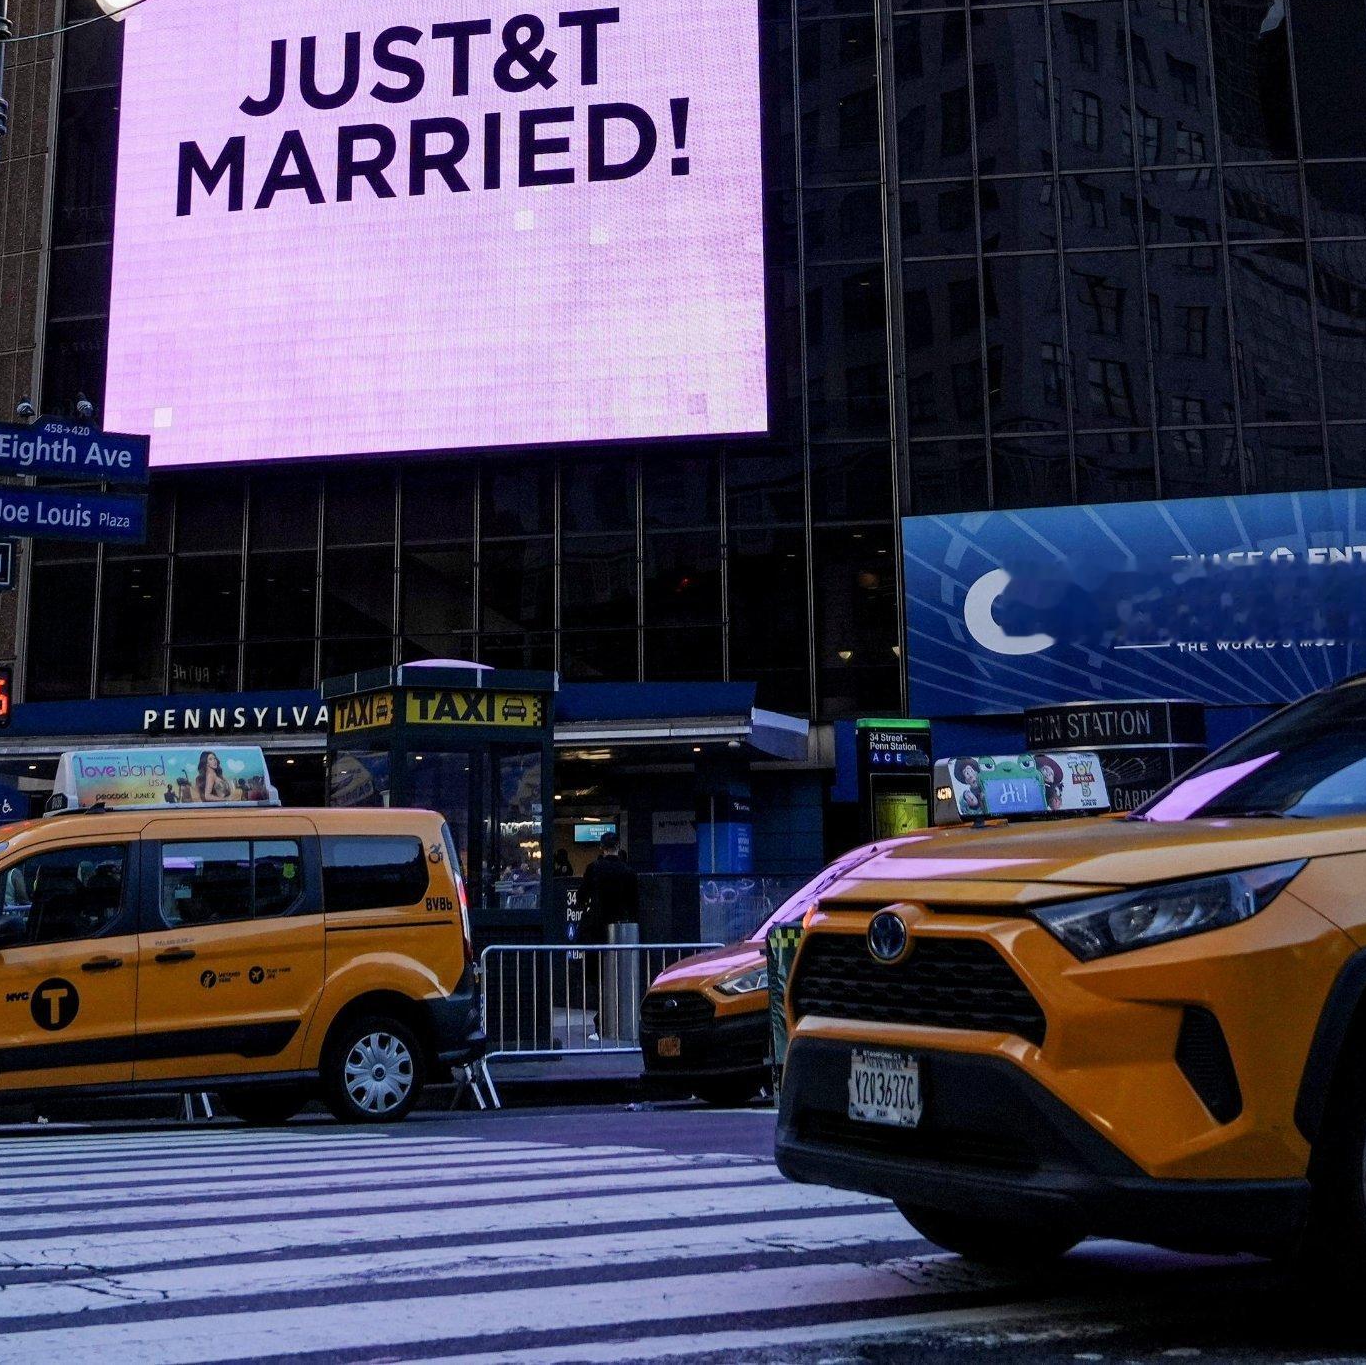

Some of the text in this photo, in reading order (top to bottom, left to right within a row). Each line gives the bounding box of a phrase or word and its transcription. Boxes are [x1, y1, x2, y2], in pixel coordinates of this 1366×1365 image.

[239, 7, 620, 116] JUST&T
[176, 97, 690, 217] MARRIED!
[44, 423, 90, 436] 458 420
[85, 441, 132, 468] Ave
[37, 502, 91, 527] Louis
[99, 512, 130, 528] Plaza
[143, 705, 329, 730] PENNSYLVA
[337, 694, 374, 730] TAXI
[412, 691, 496, 722] TAXI
[1067, 709, 1151, 738] STATION
[869, 733, 879, 742] 34
[869, 742, 917, 751] Penn Station
[79, 755, 166, 778] love island
[873, 753, 902, 762] A C E
[148, 779, 166, 787] USA
[1000, 782, 1028, 804] Hi!
[96, 792, 129, 801] peacock
[566, 891, 577, 906] 34
